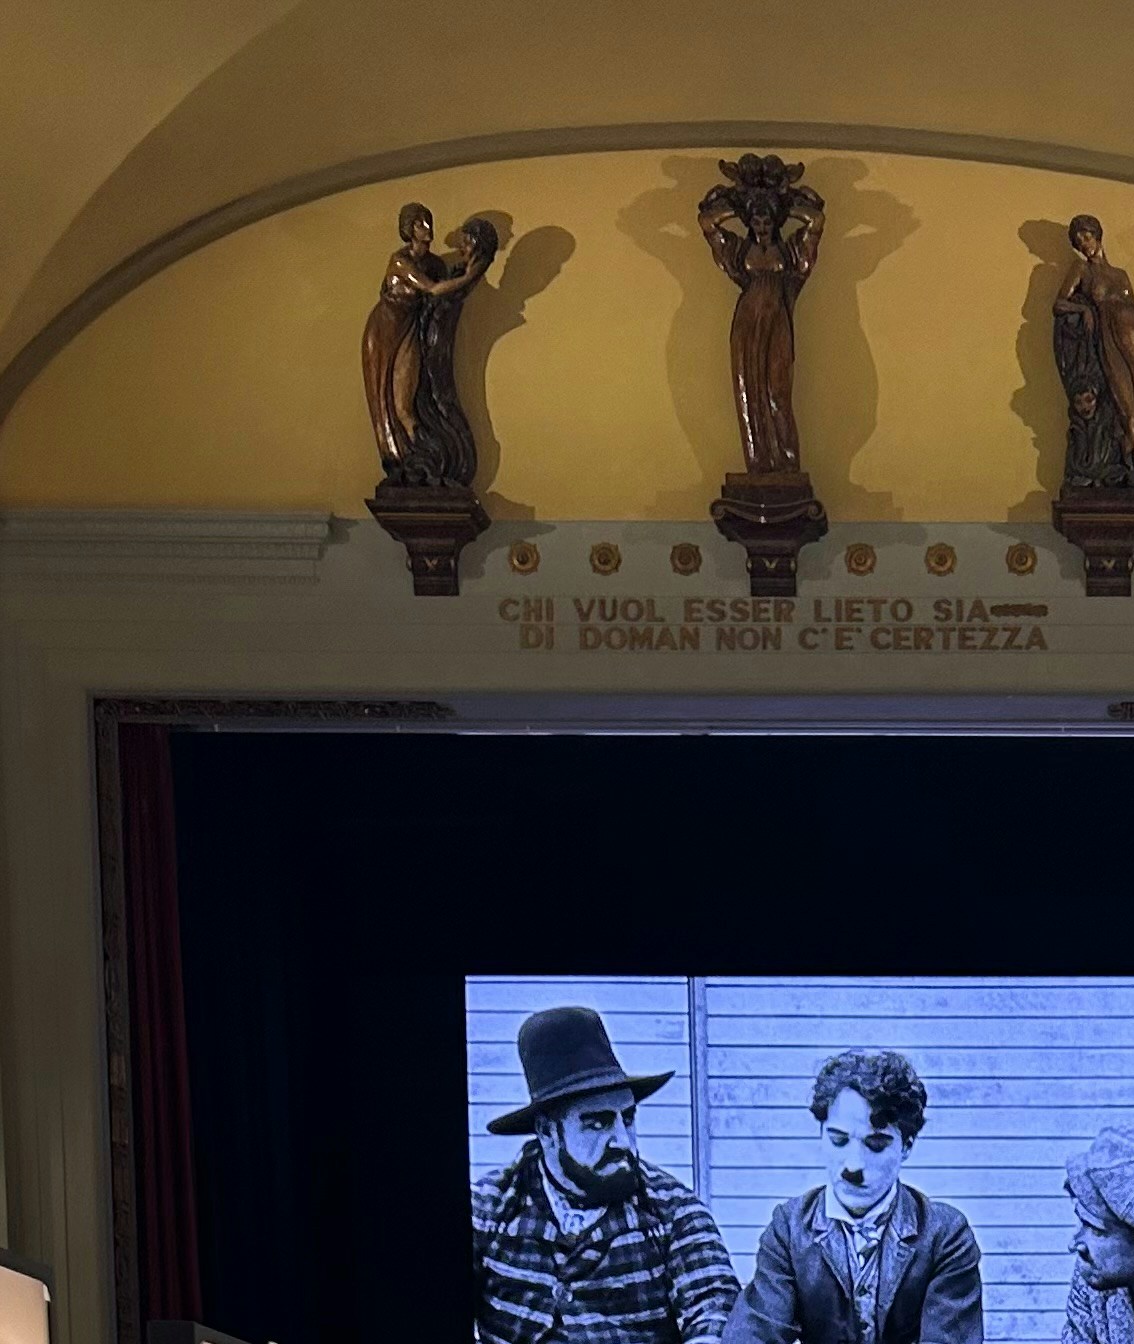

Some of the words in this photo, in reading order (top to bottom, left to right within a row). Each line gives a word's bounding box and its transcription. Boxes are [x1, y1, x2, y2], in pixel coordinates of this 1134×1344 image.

[500, 600, 554, 624] CHI
[575, 600, 665, 624] VUOL
[685, 600, 796, 624] ESSER
[813, 600, 913, 623] LIETO
[933, 599, 991, 623] SIA
[519, 626, 554, 649] DI
[579, 625, 699, 650] DOMAN
[716, 625, 782, 650] NON
[869, 624, 1048, 650] CERTEZZA
